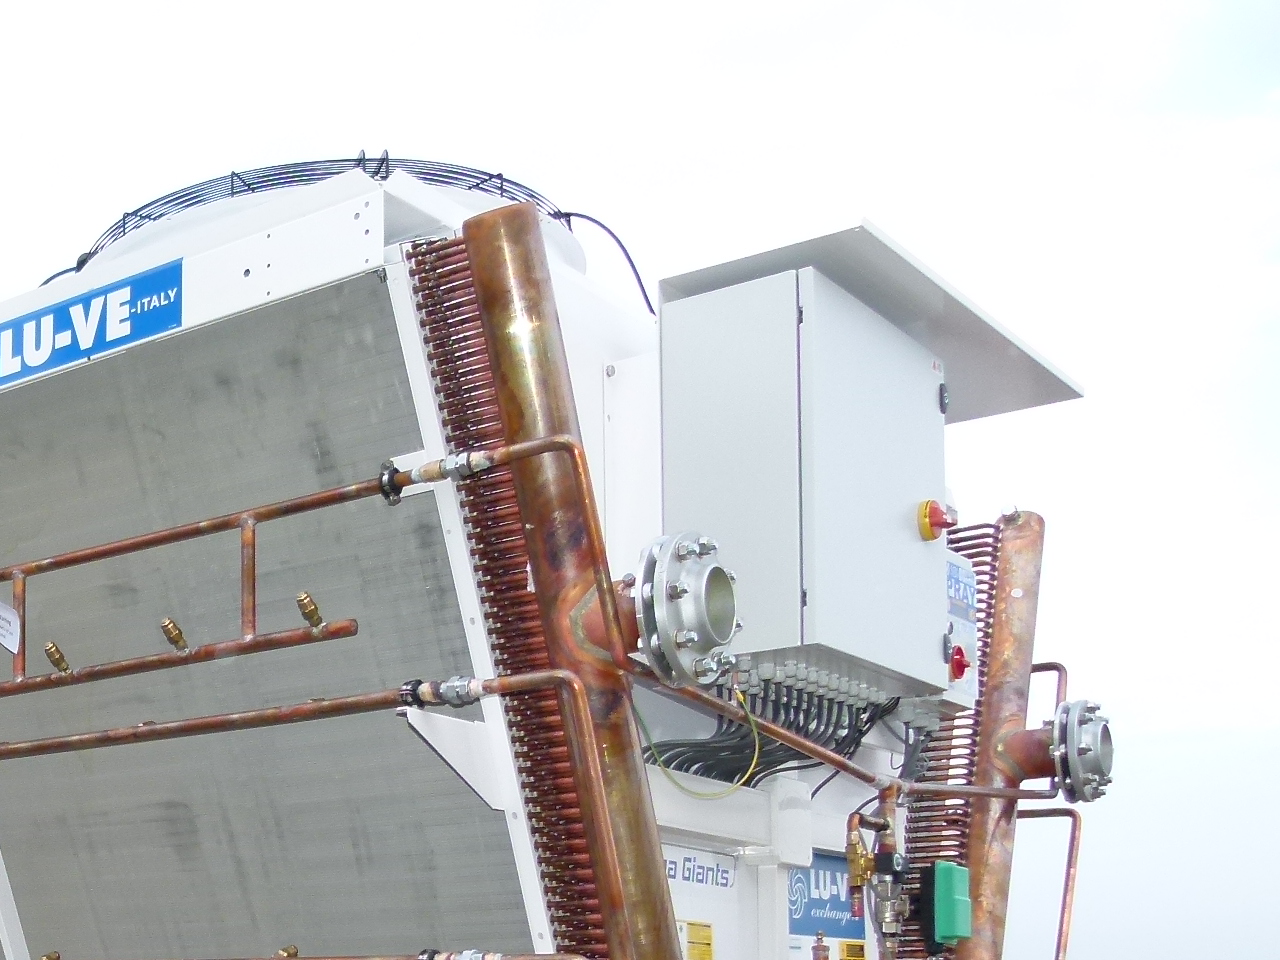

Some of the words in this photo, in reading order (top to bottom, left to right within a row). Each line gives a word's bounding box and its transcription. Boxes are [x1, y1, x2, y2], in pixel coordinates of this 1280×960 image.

[0, 286, 131, 378] LU-VE
[682, 857, 730, 888] Giants
[809, 869, 849, 901] LU-V
[811, 903, 859, 926] exchange
